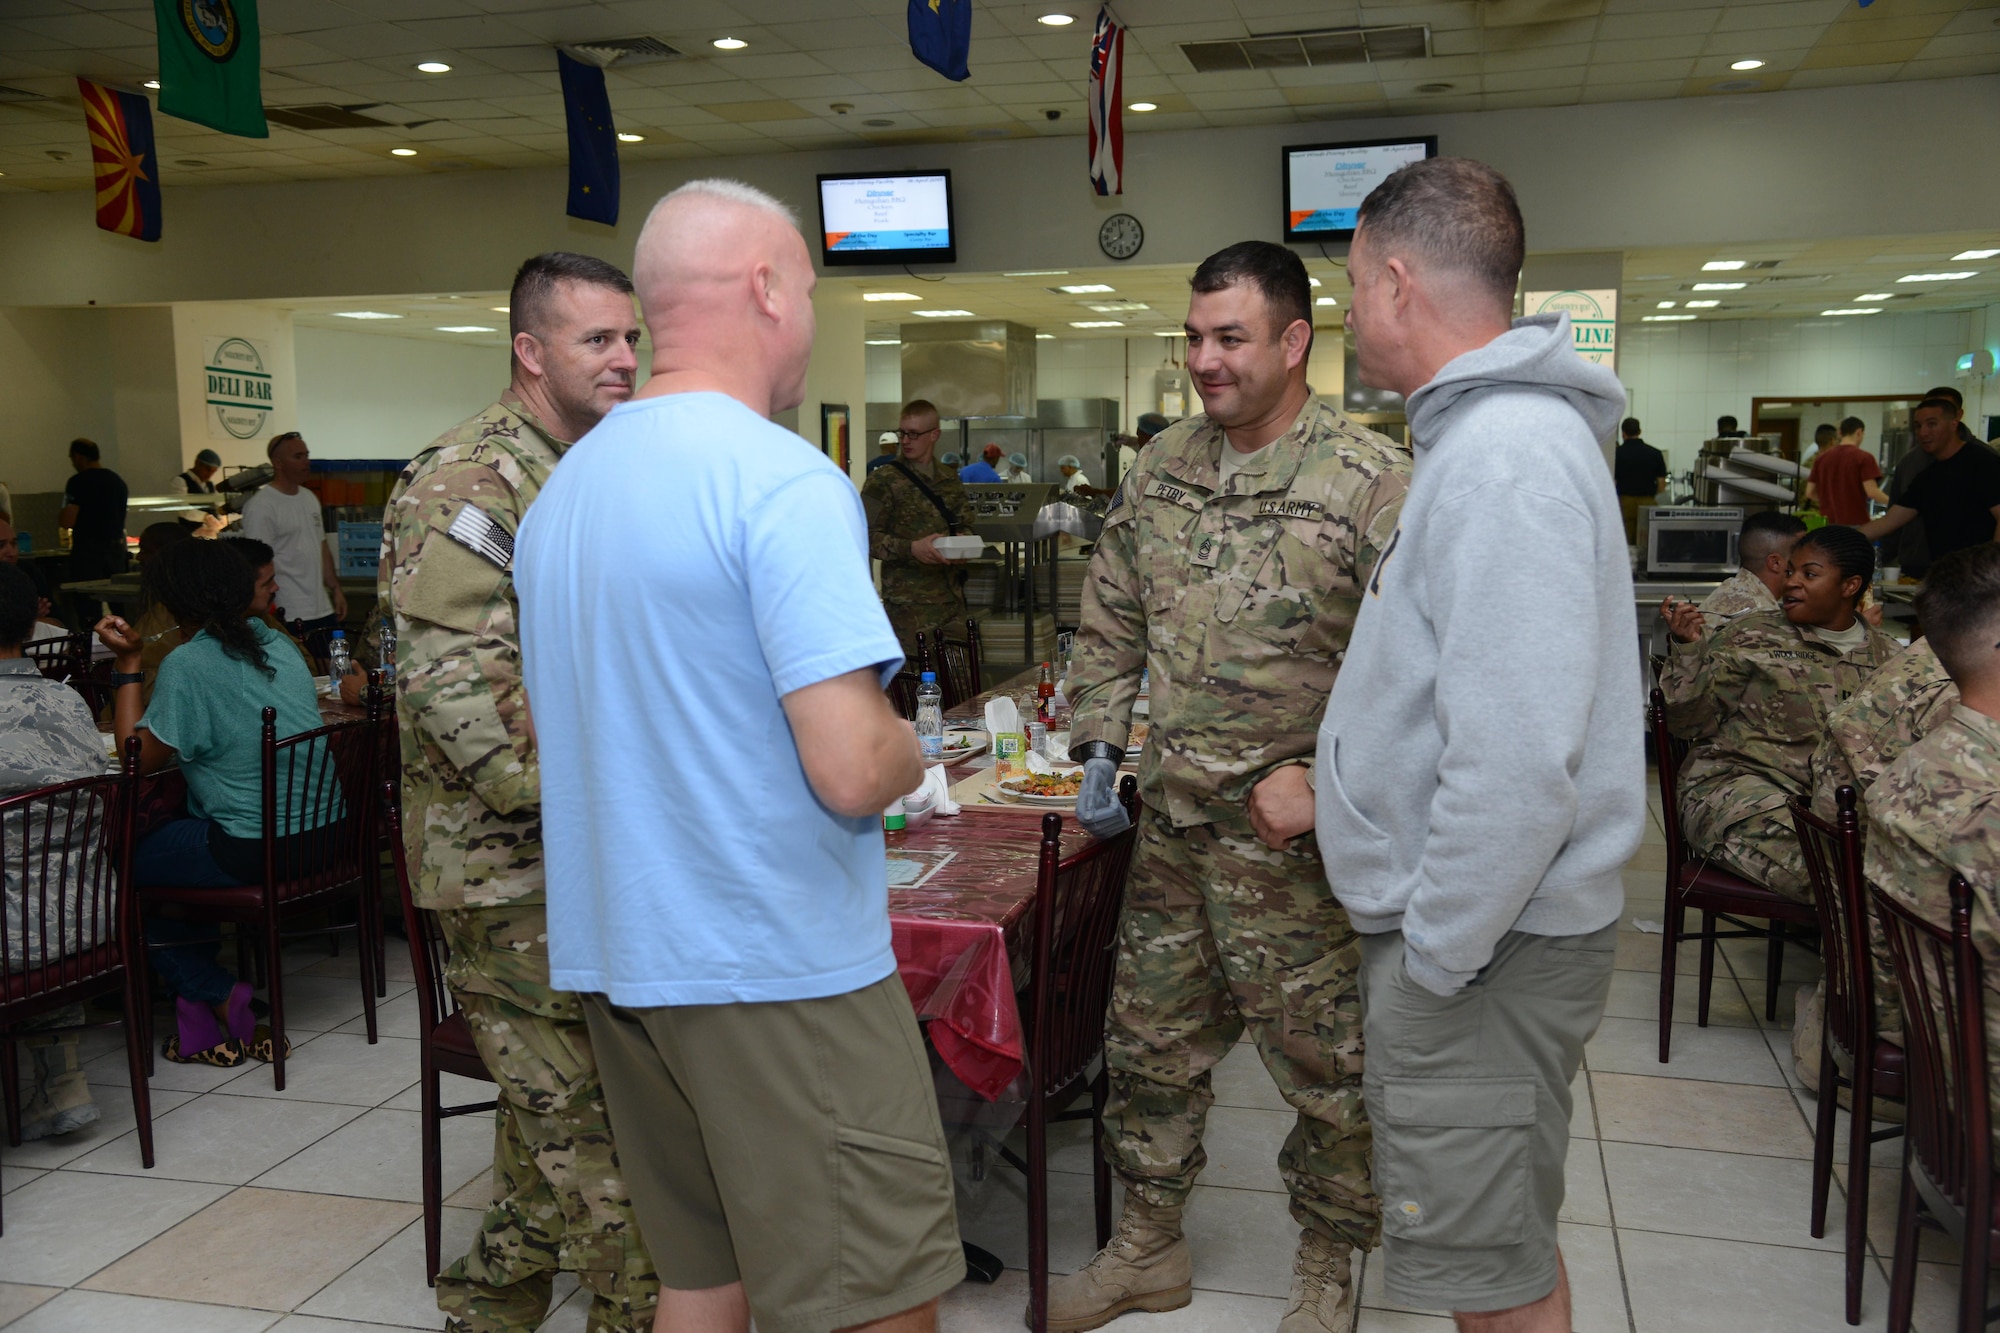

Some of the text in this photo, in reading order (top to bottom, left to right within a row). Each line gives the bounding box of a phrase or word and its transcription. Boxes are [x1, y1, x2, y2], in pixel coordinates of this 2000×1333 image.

[1575, 327, 1614, 343] LINE
[208, 375, 272, 400] DELI BAR
[1155, 483, 1187, 501] PETRY
